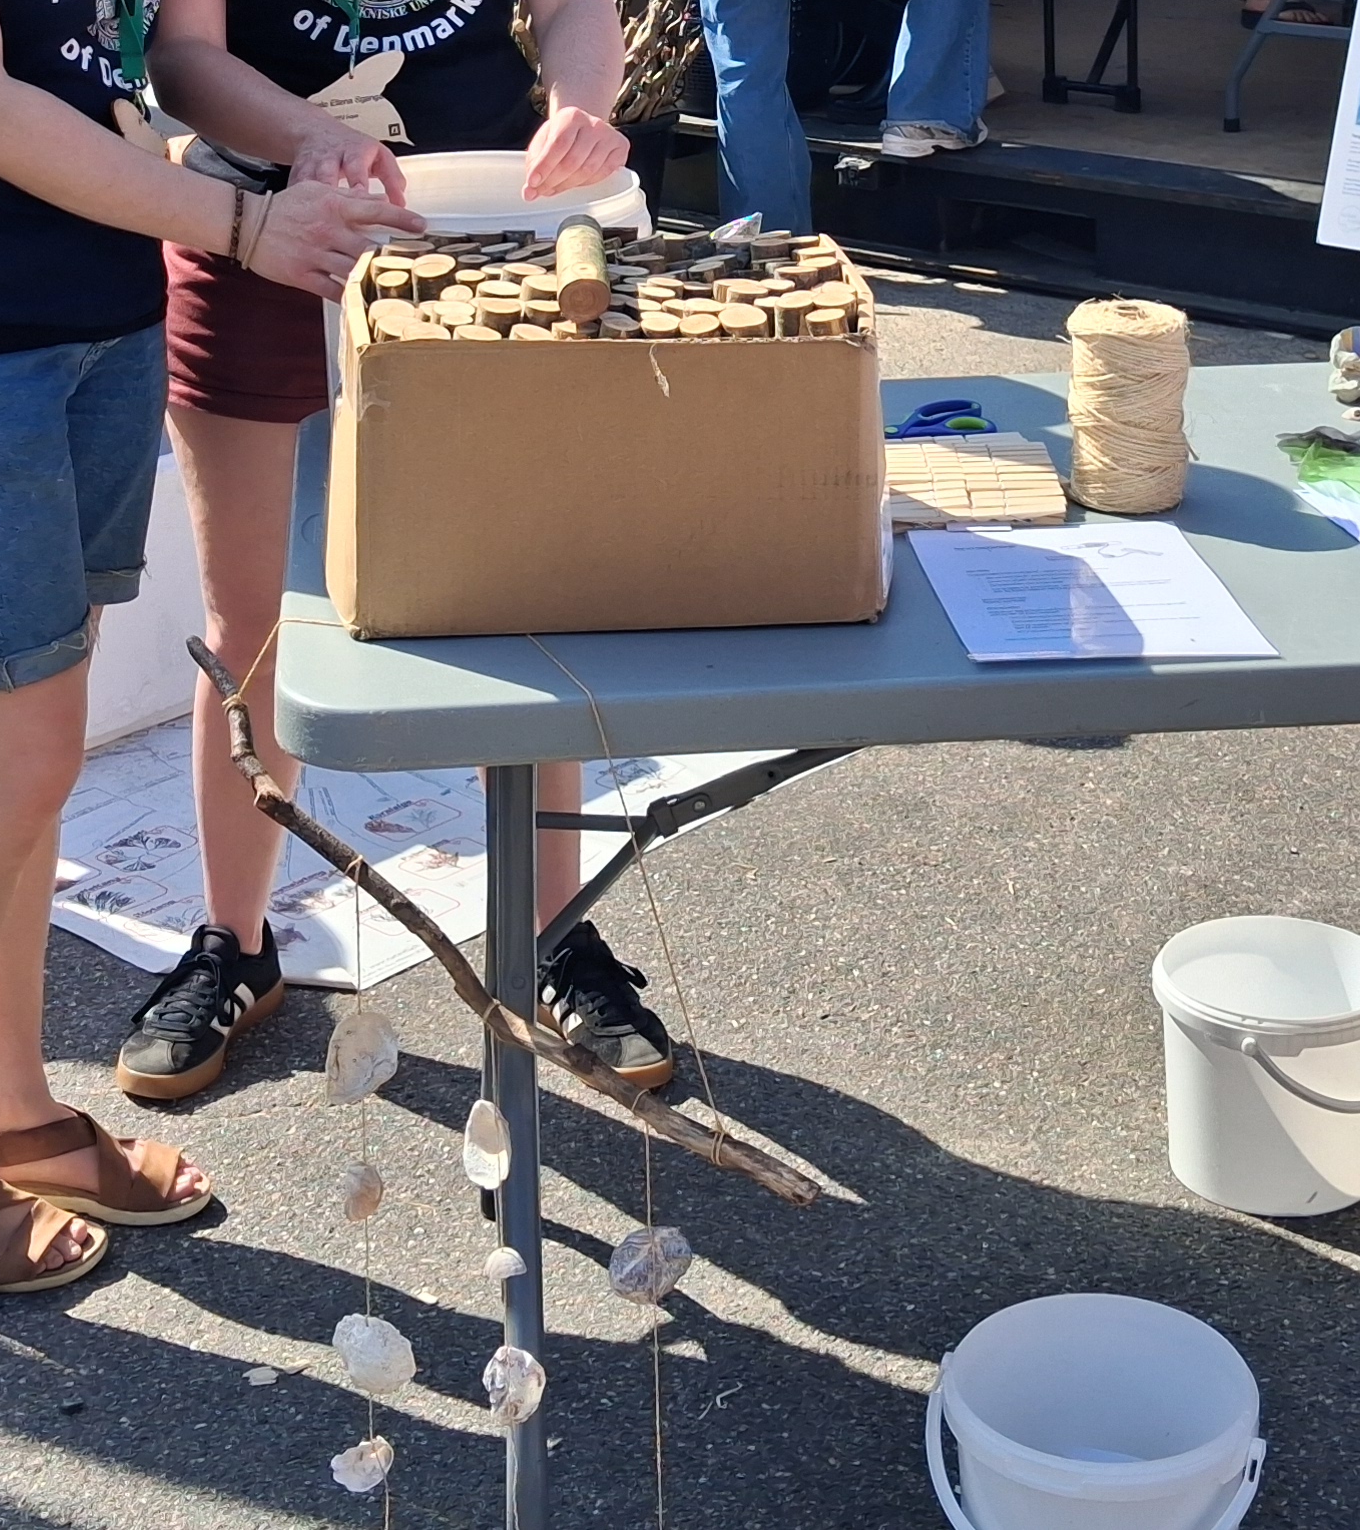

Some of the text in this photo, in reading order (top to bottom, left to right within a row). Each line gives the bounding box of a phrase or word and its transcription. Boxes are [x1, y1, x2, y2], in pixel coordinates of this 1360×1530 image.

[293, 9, 332, 40] of
[357, 6, 409, 20] KNISKE
[60, 37, 94, 71] of
